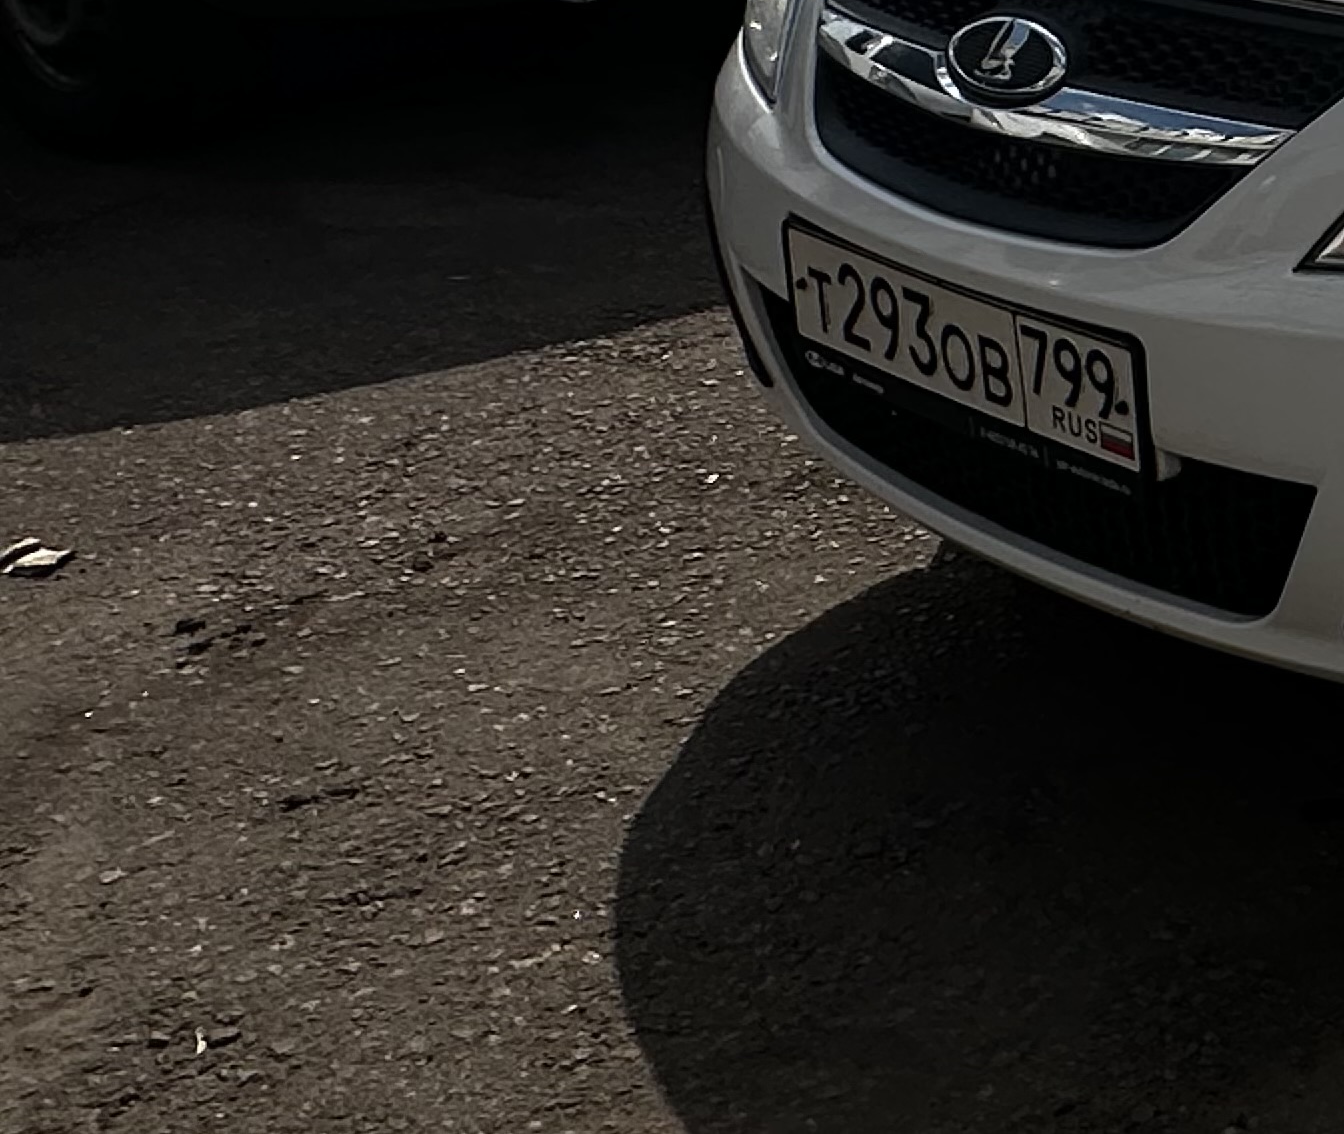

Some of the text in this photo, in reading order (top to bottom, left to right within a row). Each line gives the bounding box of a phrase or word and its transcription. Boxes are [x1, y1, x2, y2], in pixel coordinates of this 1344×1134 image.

[807, 263, 1117, 419] Т293ОВ 799
[1051, 405, 1098, 444] RUS
